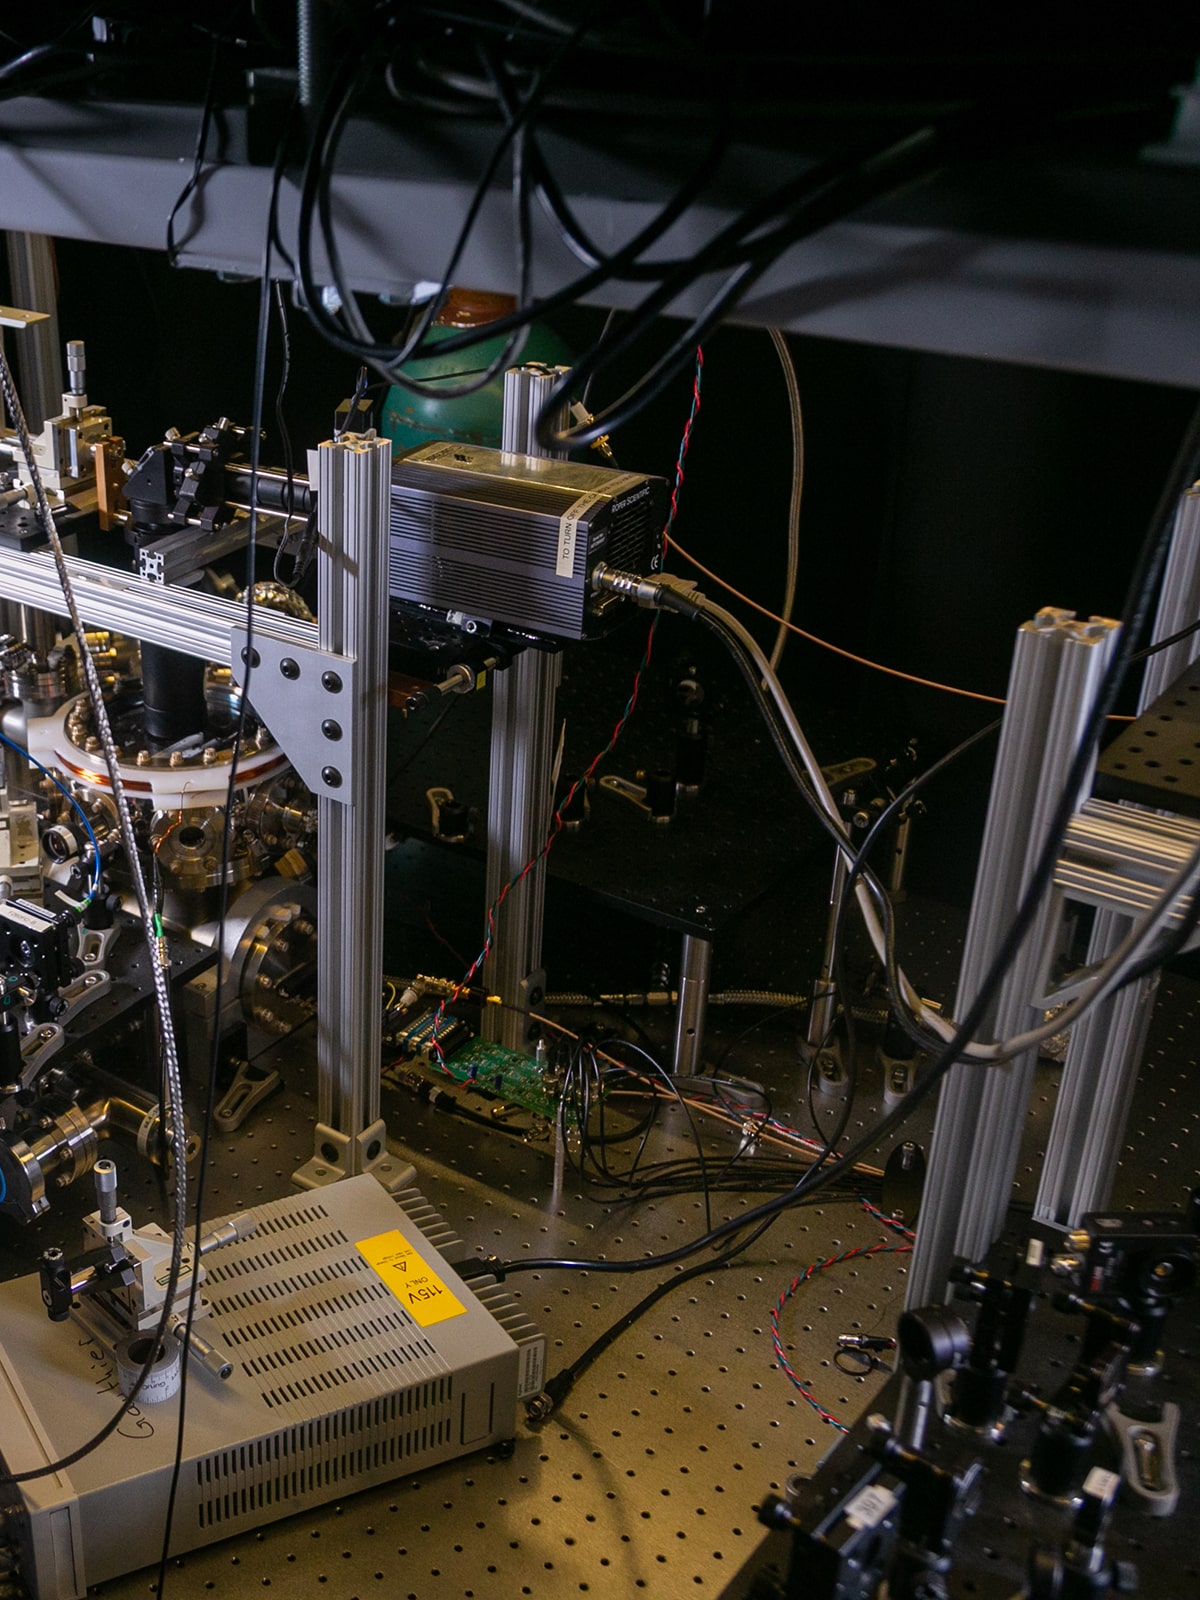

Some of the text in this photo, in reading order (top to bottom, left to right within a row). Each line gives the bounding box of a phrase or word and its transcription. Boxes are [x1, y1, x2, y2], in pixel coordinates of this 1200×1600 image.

[567, 508, 580, 521] OFF
[564, 523, 572, 545] TURN
[562, 548, 570, 560] TO
[405, 1276, 429, 1288] ONLY
[408, 1285, 443, 1304] 115V
